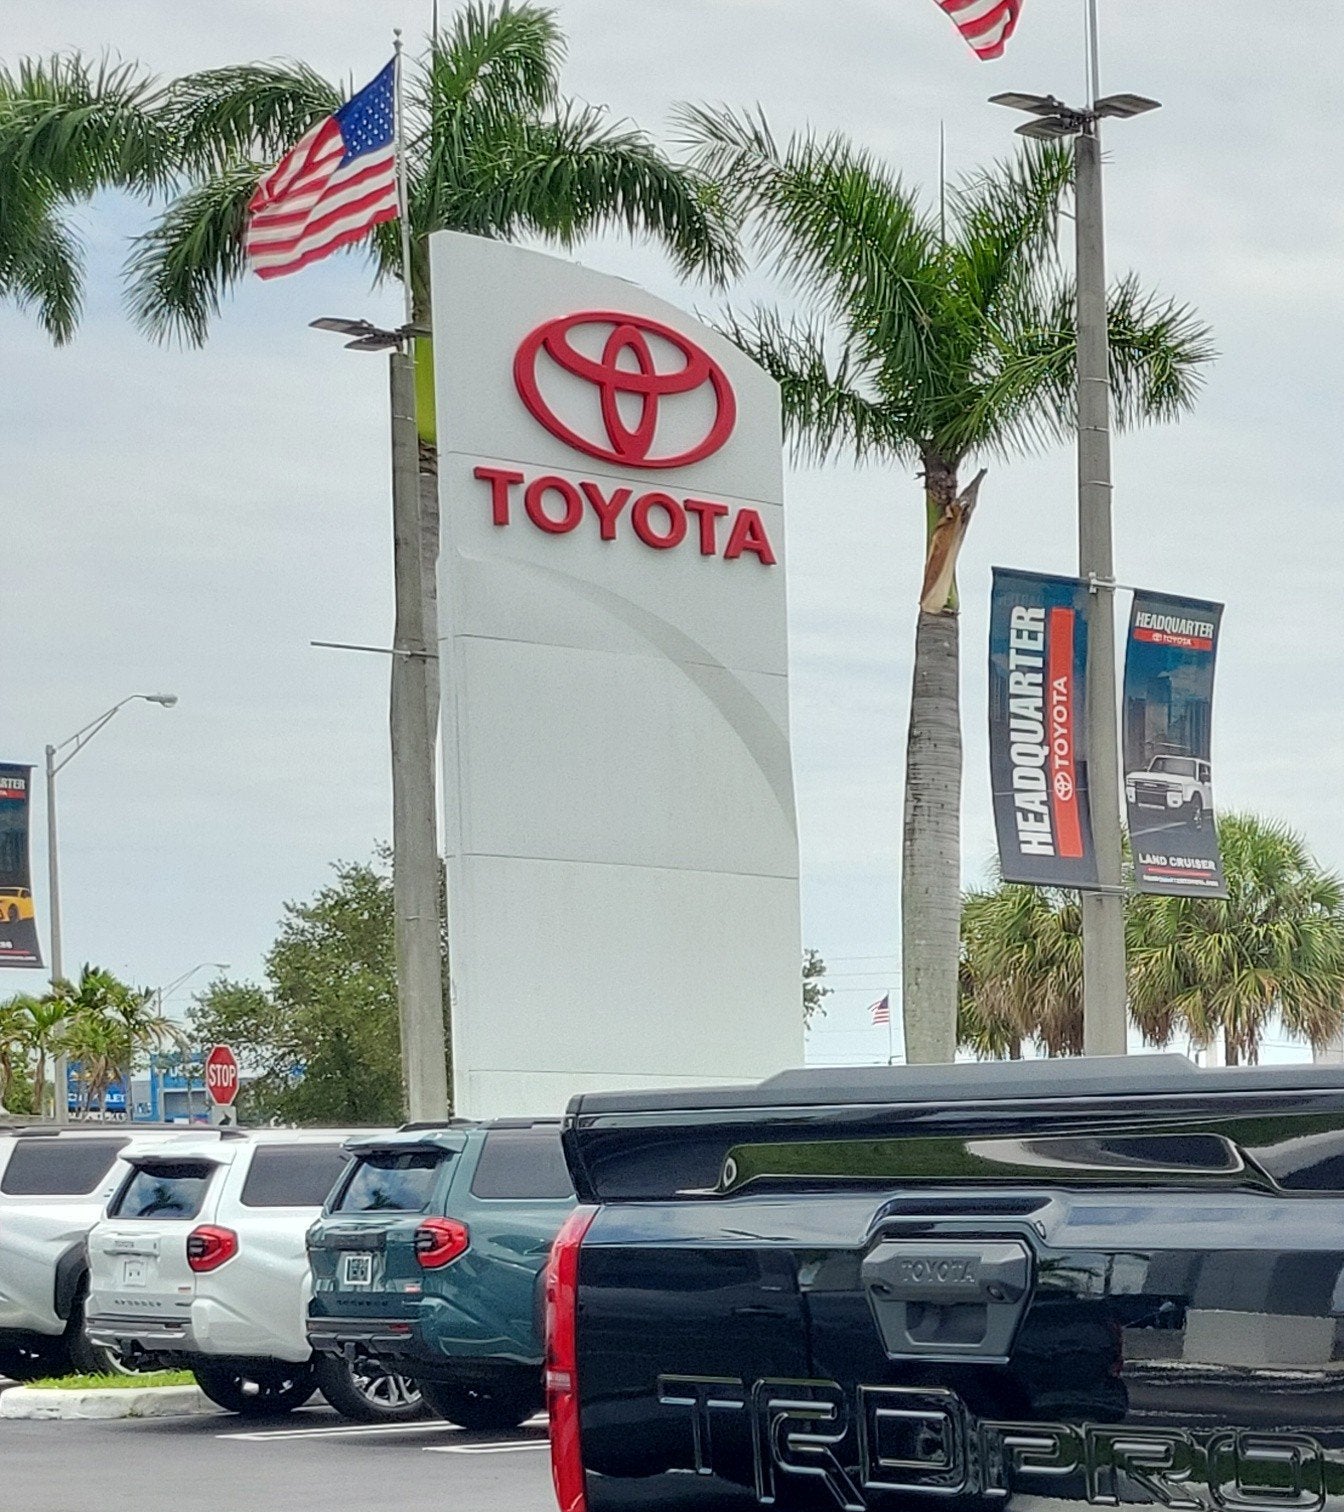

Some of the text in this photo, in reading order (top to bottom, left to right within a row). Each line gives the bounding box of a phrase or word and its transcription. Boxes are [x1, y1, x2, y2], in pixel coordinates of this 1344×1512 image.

[473, 466, 777, 565] TOYOTA
[1135, 611, 1215, 639] HEADQUARTER
[1163, 634, 1192, 646] TOYOTA
[1008, 605, 1056, 857] HEADQUARTER
[1052, 676, 1073, 769] TOYOTA
[1138, 853, 1216, 871] LAND CRUISER
[208, 1064, 236, 1088] STOP
[901, 1259, 976, 1284] TOYOTA
[658, 1373, 969, 1512] TRD
